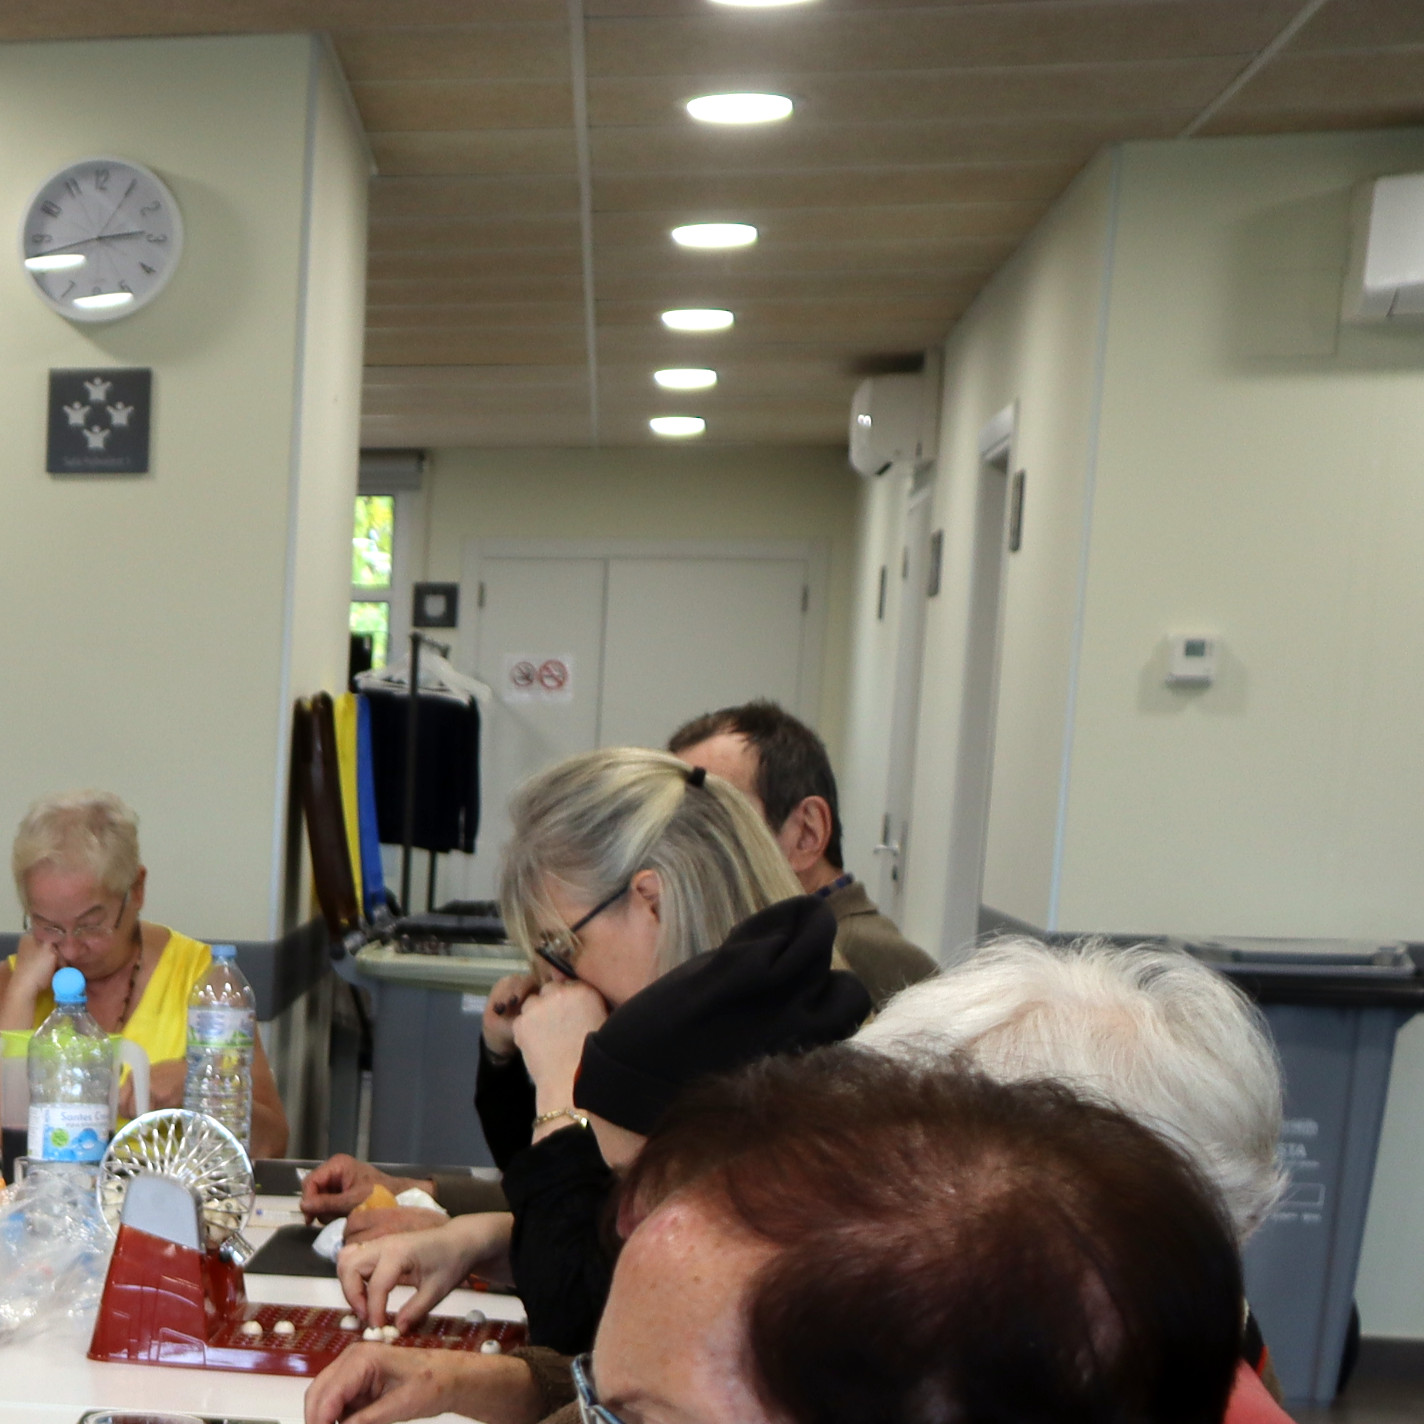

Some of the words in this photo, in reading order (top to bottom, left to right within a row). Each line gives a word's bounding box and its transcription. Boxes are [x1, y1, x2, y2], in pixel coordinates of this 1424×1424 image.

[95, 168, 110, 191] 12
[40, 200, 63, 219] 10
[139, 200, 161, 217] 2
[145, 233, 168, 244] 3
[139, 261, 156, 275] 4
